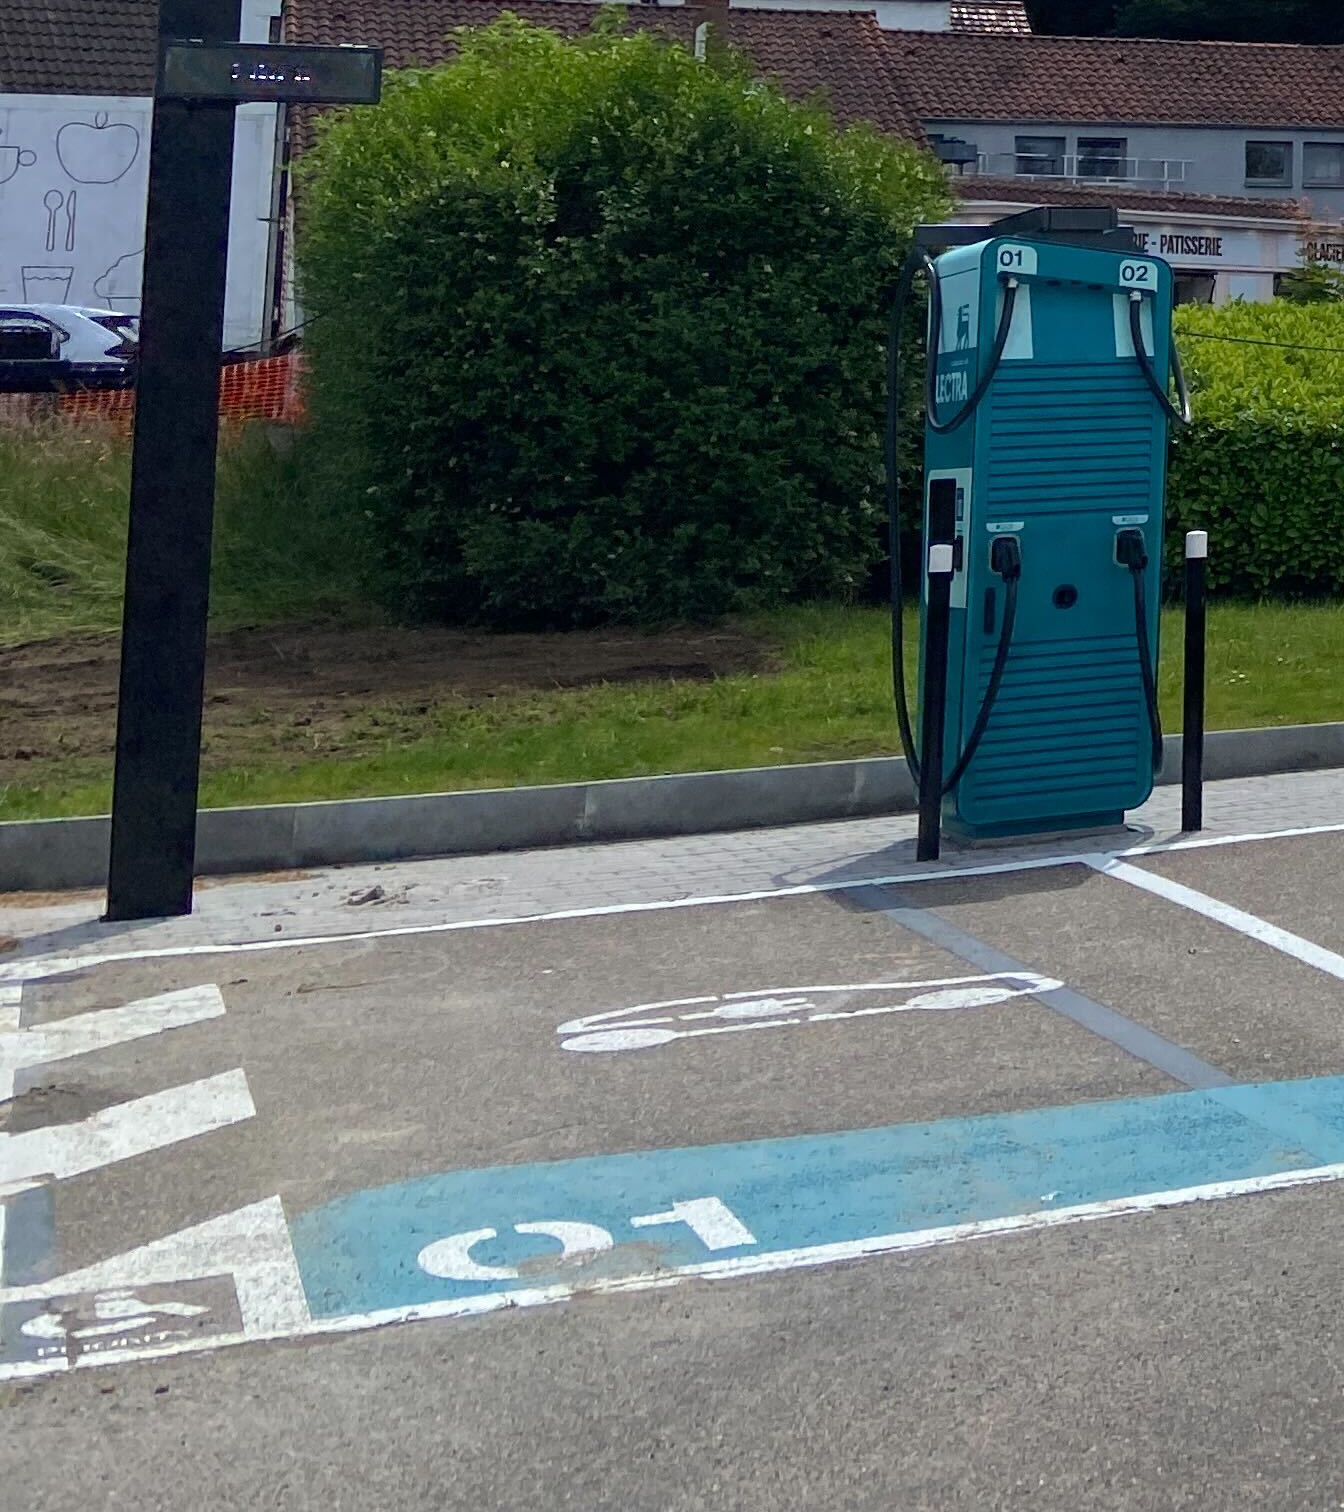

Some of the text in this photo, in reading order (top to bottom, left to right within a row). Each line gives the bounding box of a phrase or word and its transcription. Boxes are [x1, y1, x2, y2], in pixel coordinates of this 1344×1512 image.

[1160, 234, 1223, 257] PATISSERIE
[1000, 250, 1023, 266] 01
[1121, 265, 1148, 282] 02
[935, 370, 968, 404] LECTRA
[417, 1195, 757, 1281] 01
